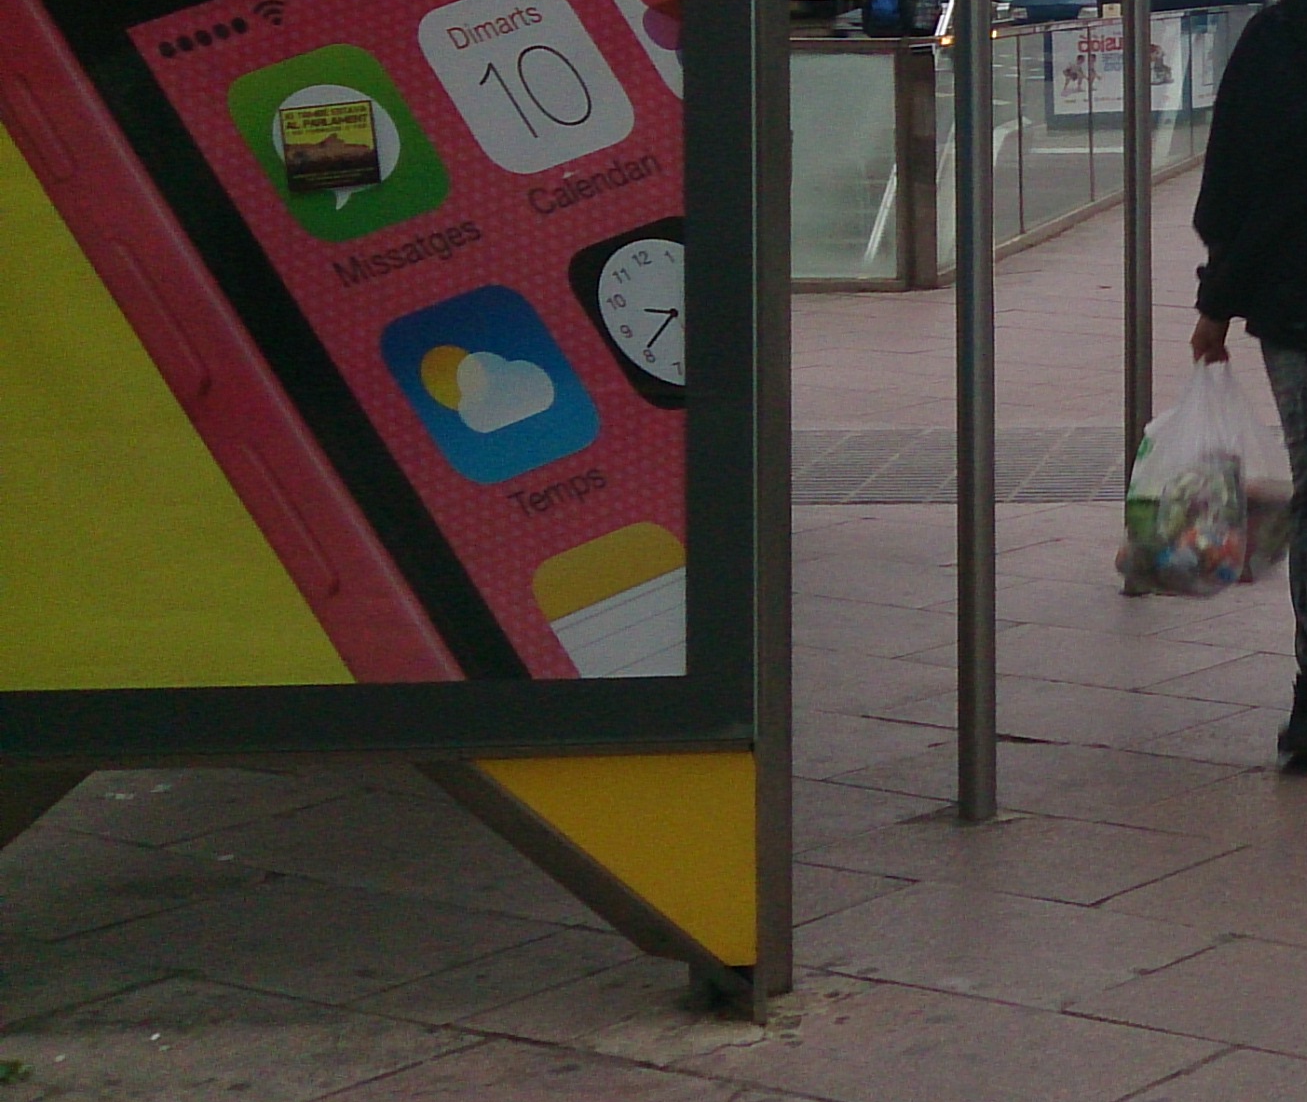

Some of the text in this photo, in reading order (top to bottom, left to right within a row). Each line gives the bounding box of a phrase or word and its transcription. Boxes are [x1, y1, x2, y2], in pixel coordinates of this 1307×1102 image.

[446, 5, 544, 51] Dimarts
[479, 45, 593, 139] 10
[332, 218, 482, 289] Missatges
[632, 250, 653, 267] 12
[612, 268, 632, 285] 11
[606, 293, 627, 311] 10
[620, 324, 634, 339] 9
[642, 348, 656, 363] 8
[506, 468, 608, 517] Temps
